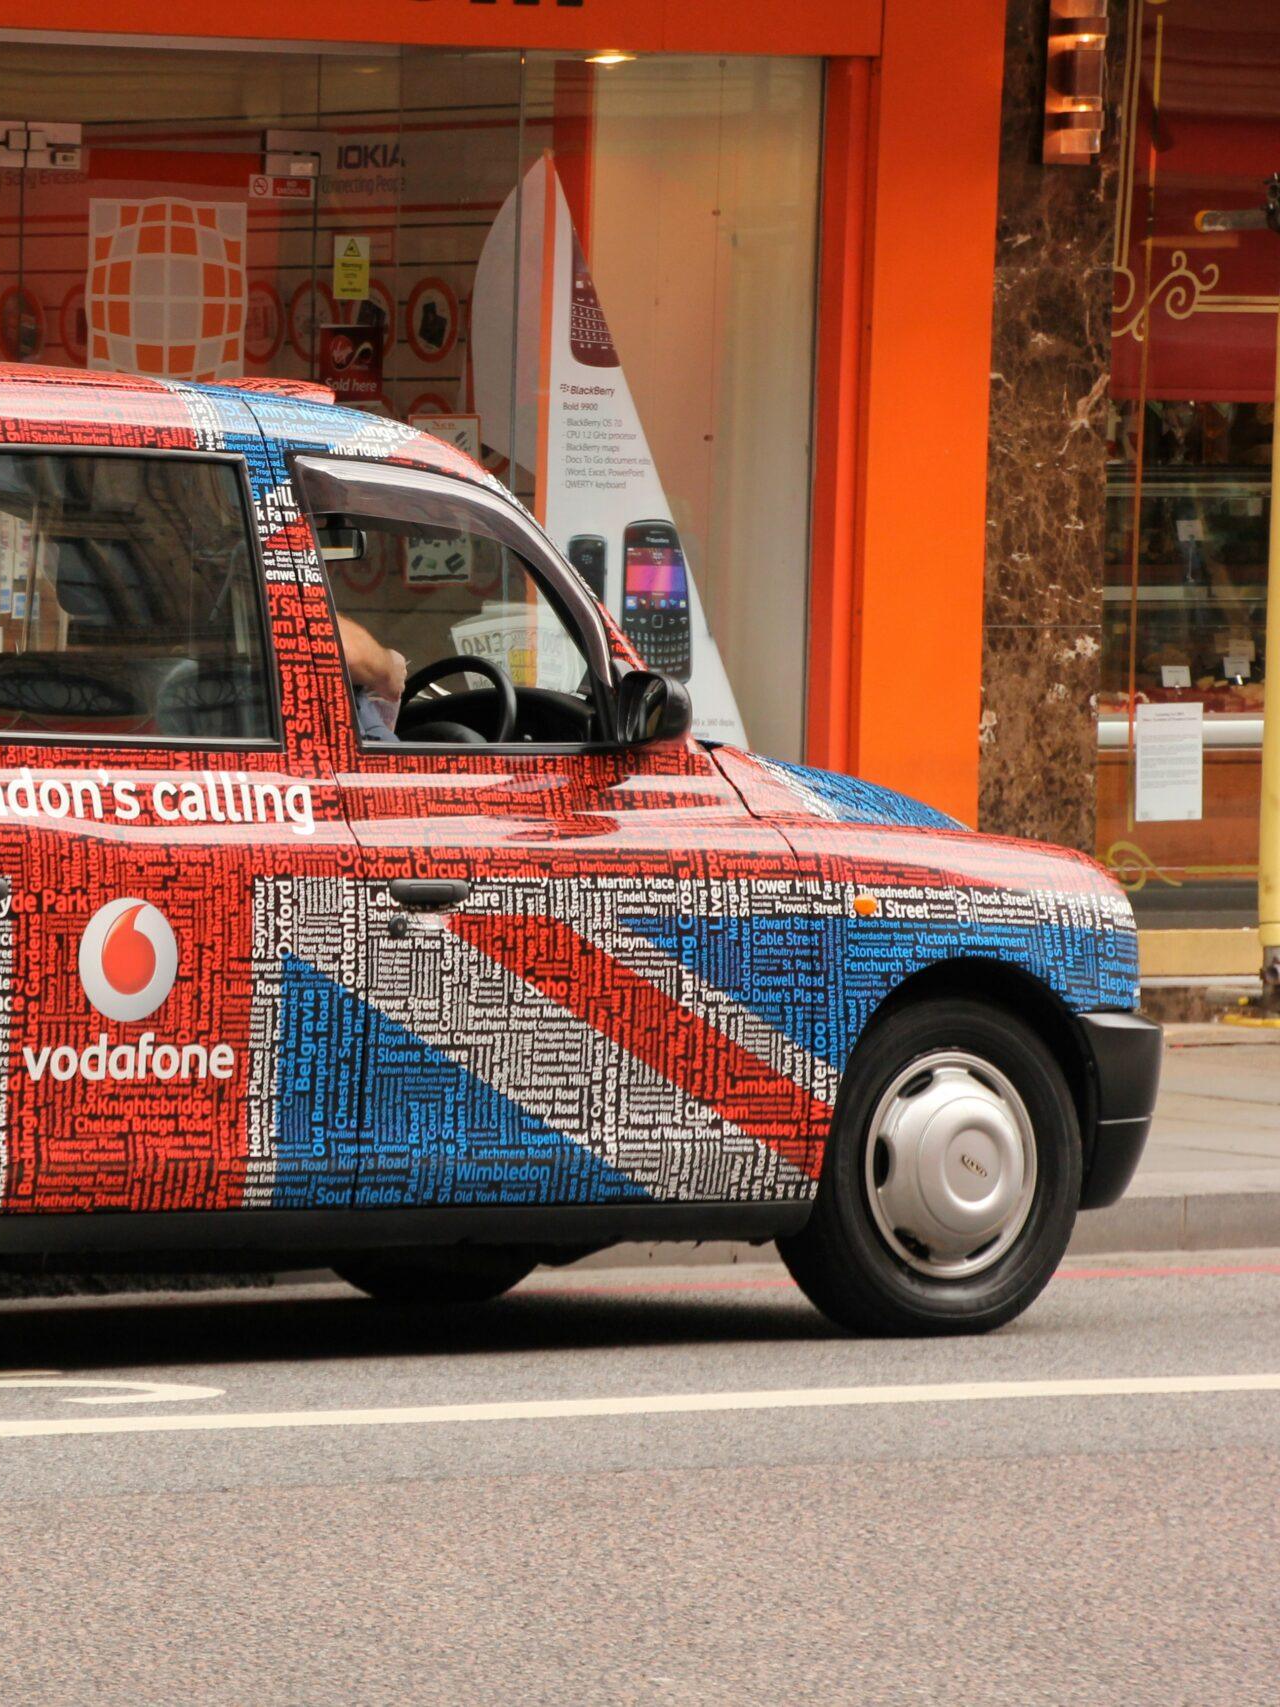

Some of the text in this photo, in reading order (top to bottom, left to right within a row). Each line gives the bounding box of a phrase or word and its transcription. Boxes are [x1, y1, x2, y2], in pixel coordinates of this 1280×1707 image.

[325, 378, 377, 392] Sold here
[570, 385, 615, 397] BlackBerry
[563, 402, 598, 412] Bold 9900
[567, 418, 601, 428] BlackBerry
[31, 432, 110, 444] Stables Market
[566, 431, 581, 440] CPU
[608, 432, 637, 441] processor
[566, 444, 620, 453] BlackBerry maps
[565, 456, 582, 464] Docs
[583, 456, 592, 464] To
[593, 456, 603, 465] Go
[604, 456, 637, 465] document
[565, 480, 626, 490] QWERTY keyboard
[152, 769, 317, 835] calling
[121, 848, 213, 864] Regent Street
[354, 860, 468, 878] Oxford Circus
[475, 864, 550, 886] Piccadilly
[580, 877, 675, 890] St. Martin's Place
[42, 891, 90, 912] Park
[617, 890, 677, 903] Endell Street
[975, 891, 1032, 907] Dock Street
[888, 900, 929, 919] Street
[957, 889, 971, 928] City
[253, 880, 266, 959] Seymour
[276, 880, 293, 960] Oxford
[379, 939, 442, 951] Market Place
[612, 934, 678, 952] Haymarket
[916, 932, 1027, 948] Victoria Embankment
[524, 977, 568, 998] Soho
[700, 988, 739, 1003] Temple
[368, 997, 441, 1010] Brewer Street
[378, 1032, 494, 1047] Royal Hospital Chelsea
[22, 1032, 234, 1082] vodafone
[377, 1046, 468, 1066] Sloane Square
[727, 1076, 792, 1095] Lambeth
[97, 1097, 212, 1118] Knightsbridge
[249, 1050, 263, 1158] Hobart Place
[603, 1068, 617, 1168] Battersea
[684, 1102, 748, 1125] Clapham
[75, 1116, 213, 1136] Chelsea Bridge Road
[521, 1133, 588, 1147] Elspeth Road
[456, 1162, 550, 1181] Wimbledon
